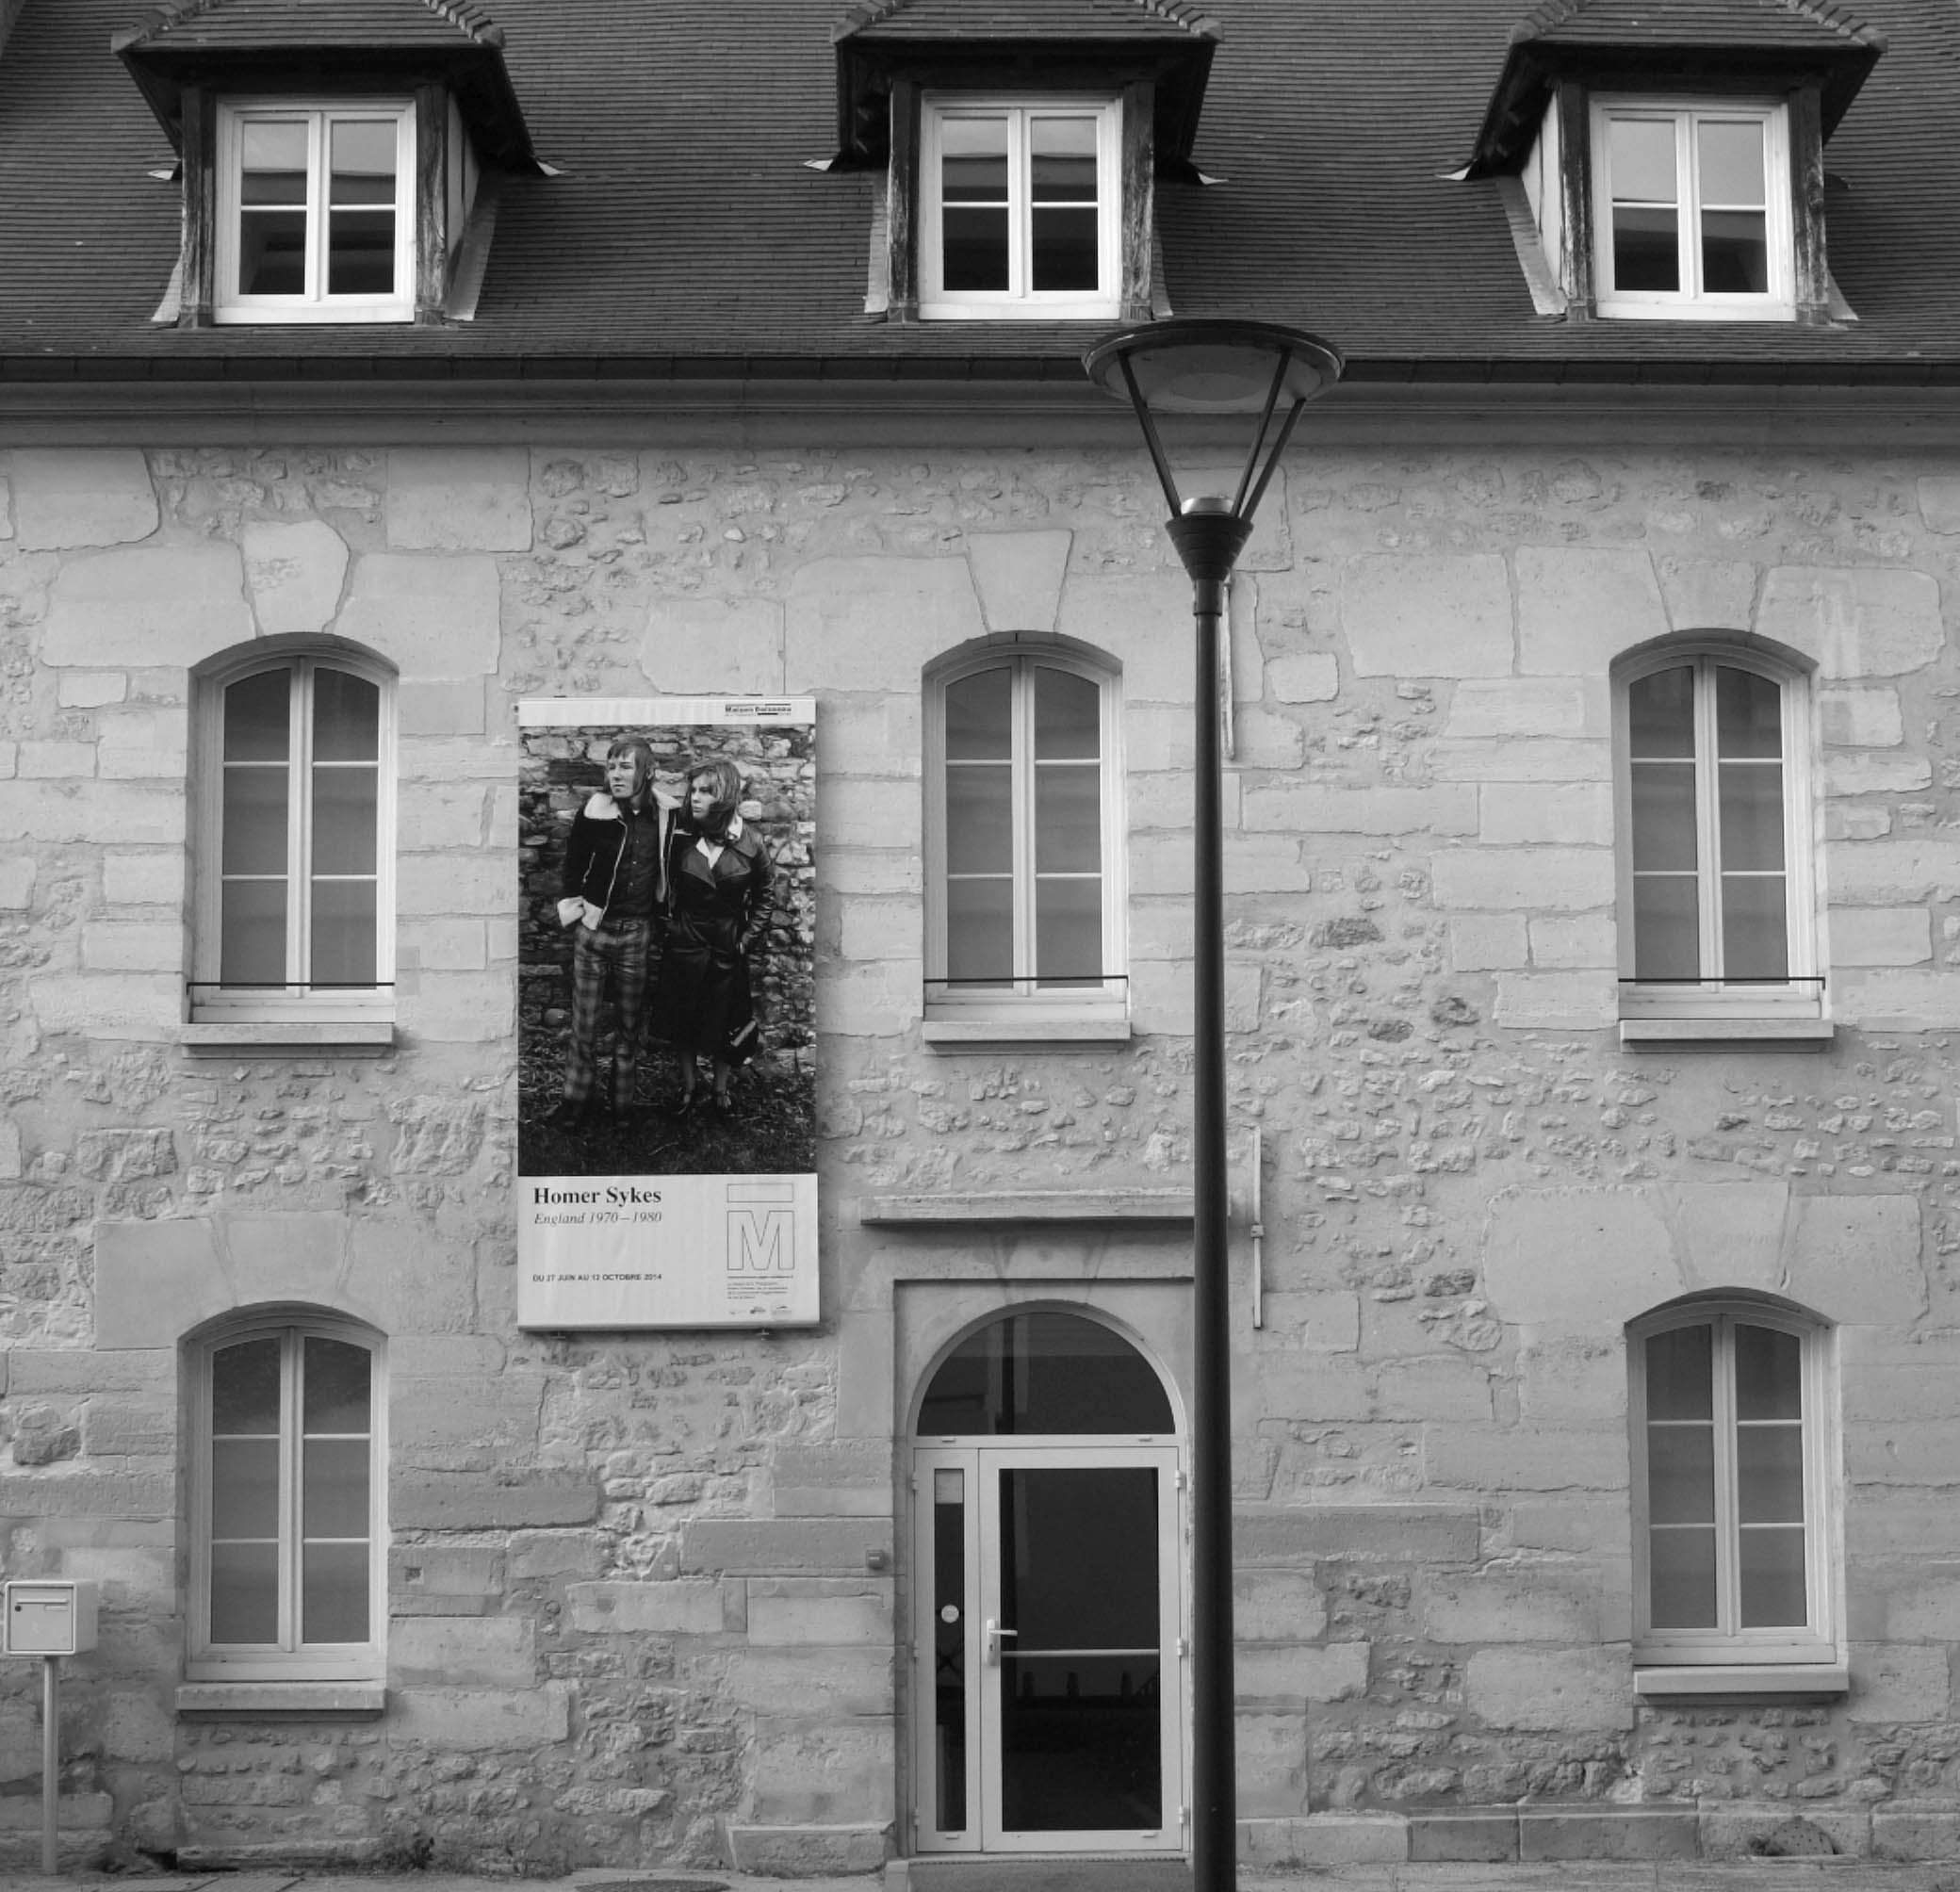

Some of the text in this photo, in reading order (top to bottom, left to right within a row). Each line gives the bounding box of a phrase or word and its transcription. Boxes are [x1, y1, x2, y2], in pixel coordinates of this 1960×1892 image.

[533, 1186, 662, 1207] Homer Sykes
[534, 1212, 586, 1228] England
[532, 1274, 545, 1282] DU
[558, 1273, 575, 1281] JUIN
[602, 1273, 641, 1281] OCTOBRE
[644, 1273, 662, 1281] 2014
